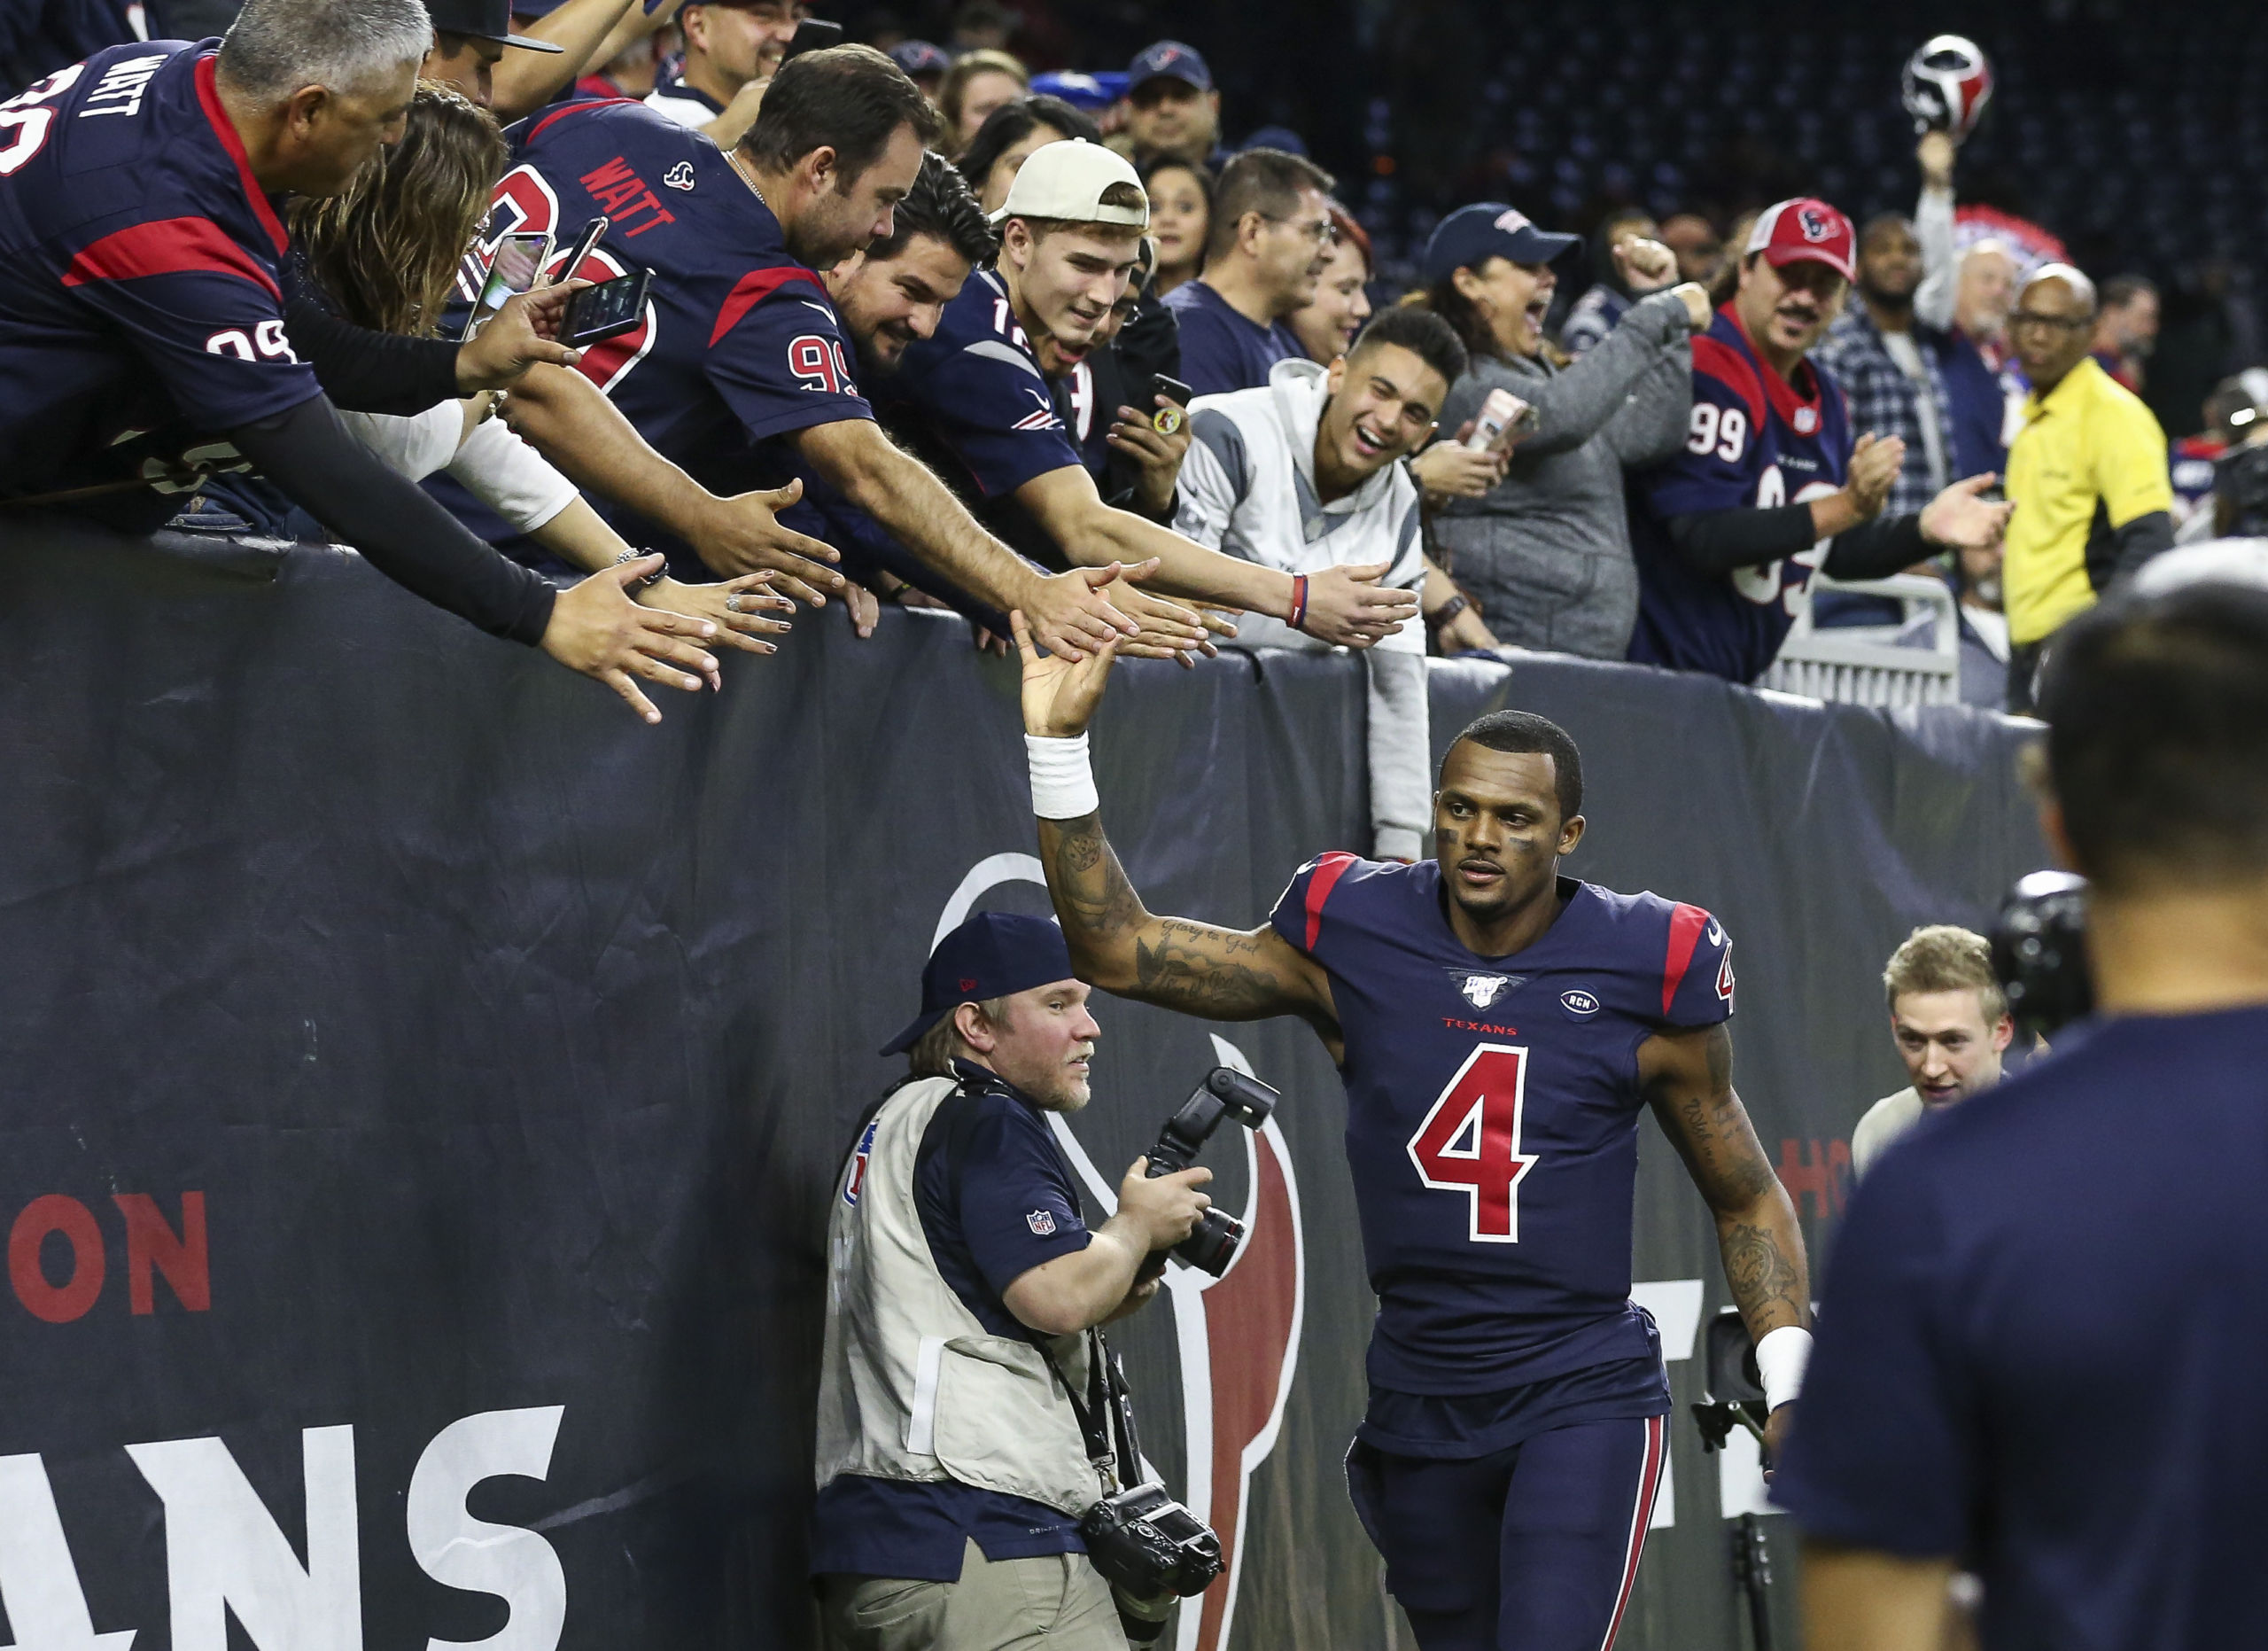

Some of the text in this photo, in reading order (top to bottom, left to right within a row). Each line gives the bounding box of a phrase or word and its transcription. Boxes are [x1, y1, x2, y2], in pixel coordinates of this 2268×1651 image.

[78, 53, 170, 118] WATT
[579, 155, 677, 238] WATT
[1687, 401, 1747, 463] 99
[1441, 1017, 1518, 1036] TEXANS
[1570, 995, 1591, 1009] RCM
[1406, 1042, 1540, 1243] 4
[7, 1190, 212, 1323] ON
